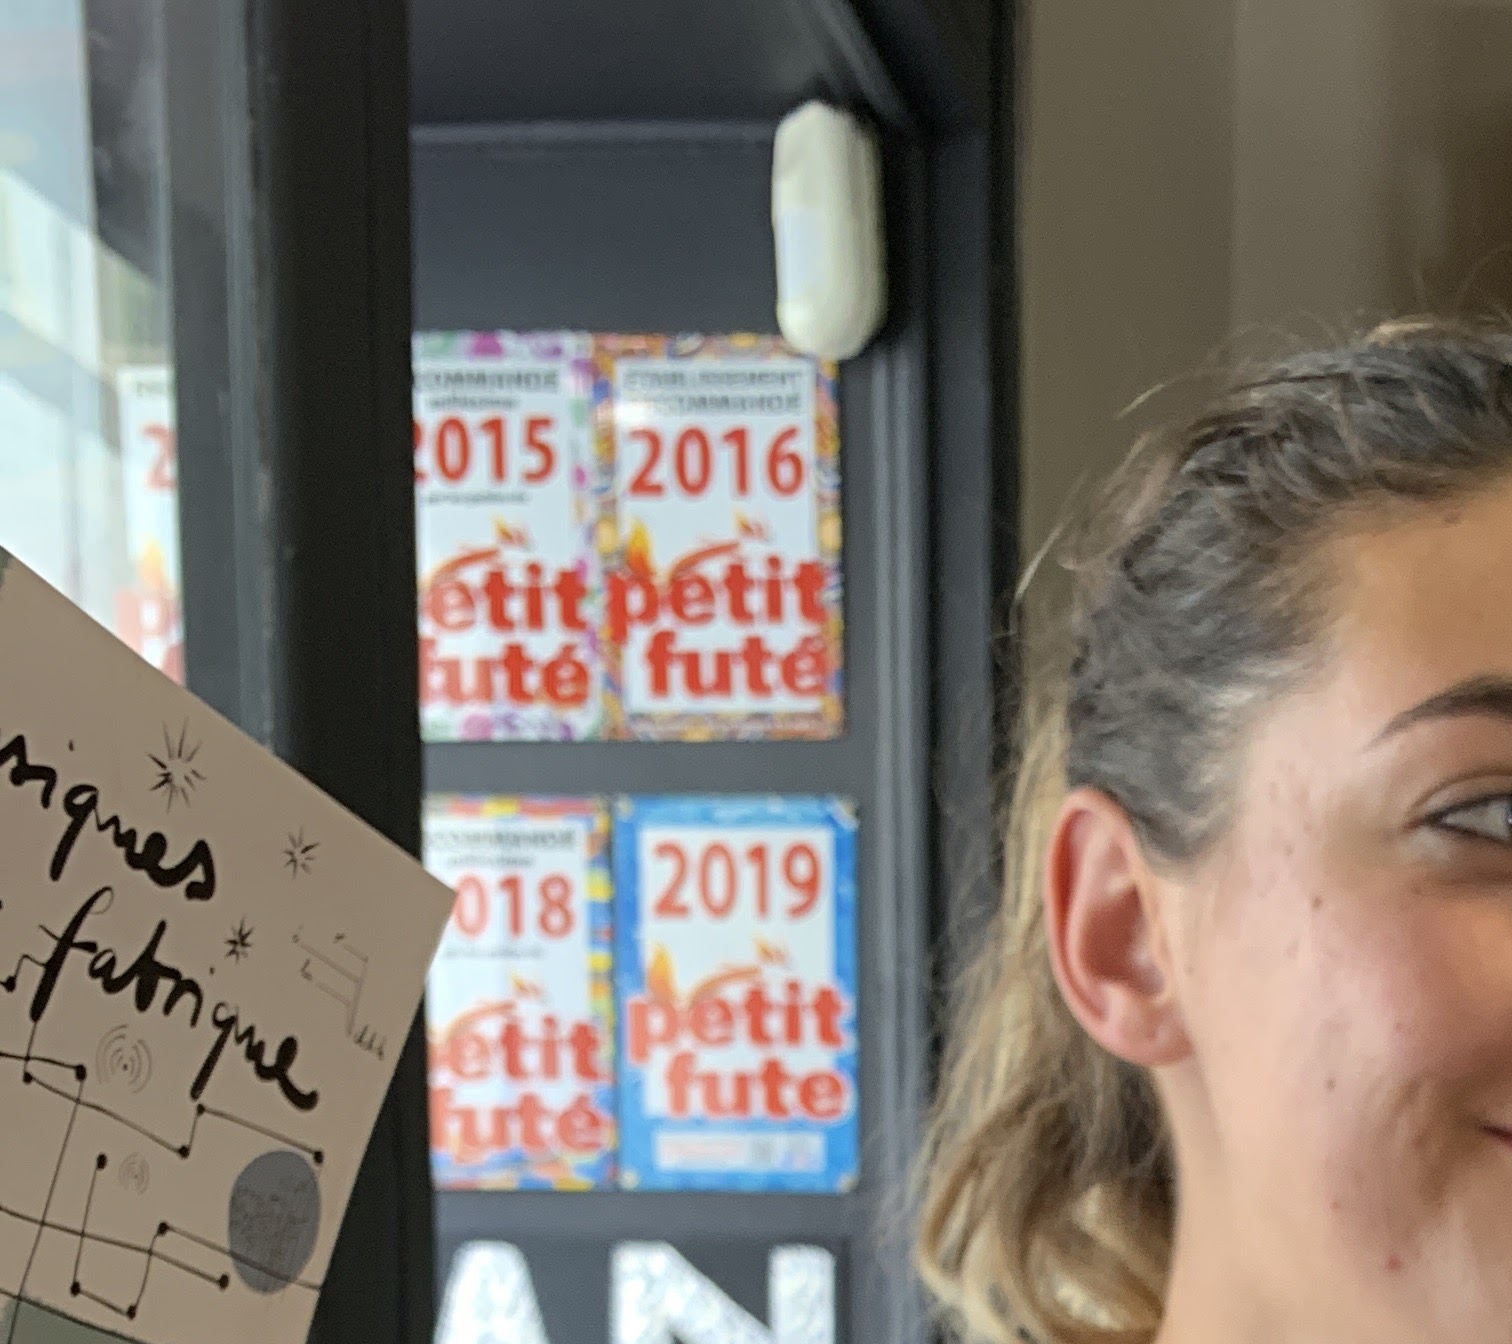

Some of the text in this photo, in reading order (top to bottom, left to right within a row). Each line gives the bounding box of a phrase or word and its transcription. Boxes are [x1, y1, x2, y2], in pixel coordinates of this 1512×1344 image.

[414, 416, 556, 483] 015
[628, 426, 804, 497] 2016
[423, 562, 588, 633] etit
[608, 555, 830, 644] petit
[455, 875, 576, 938] 018
[652, 840, 820, 920] 2019
[30, 886, 319, 1111] fabrique
[628, 980, 843, 1064] petit
[445, 1014, 602, 1082] etit
